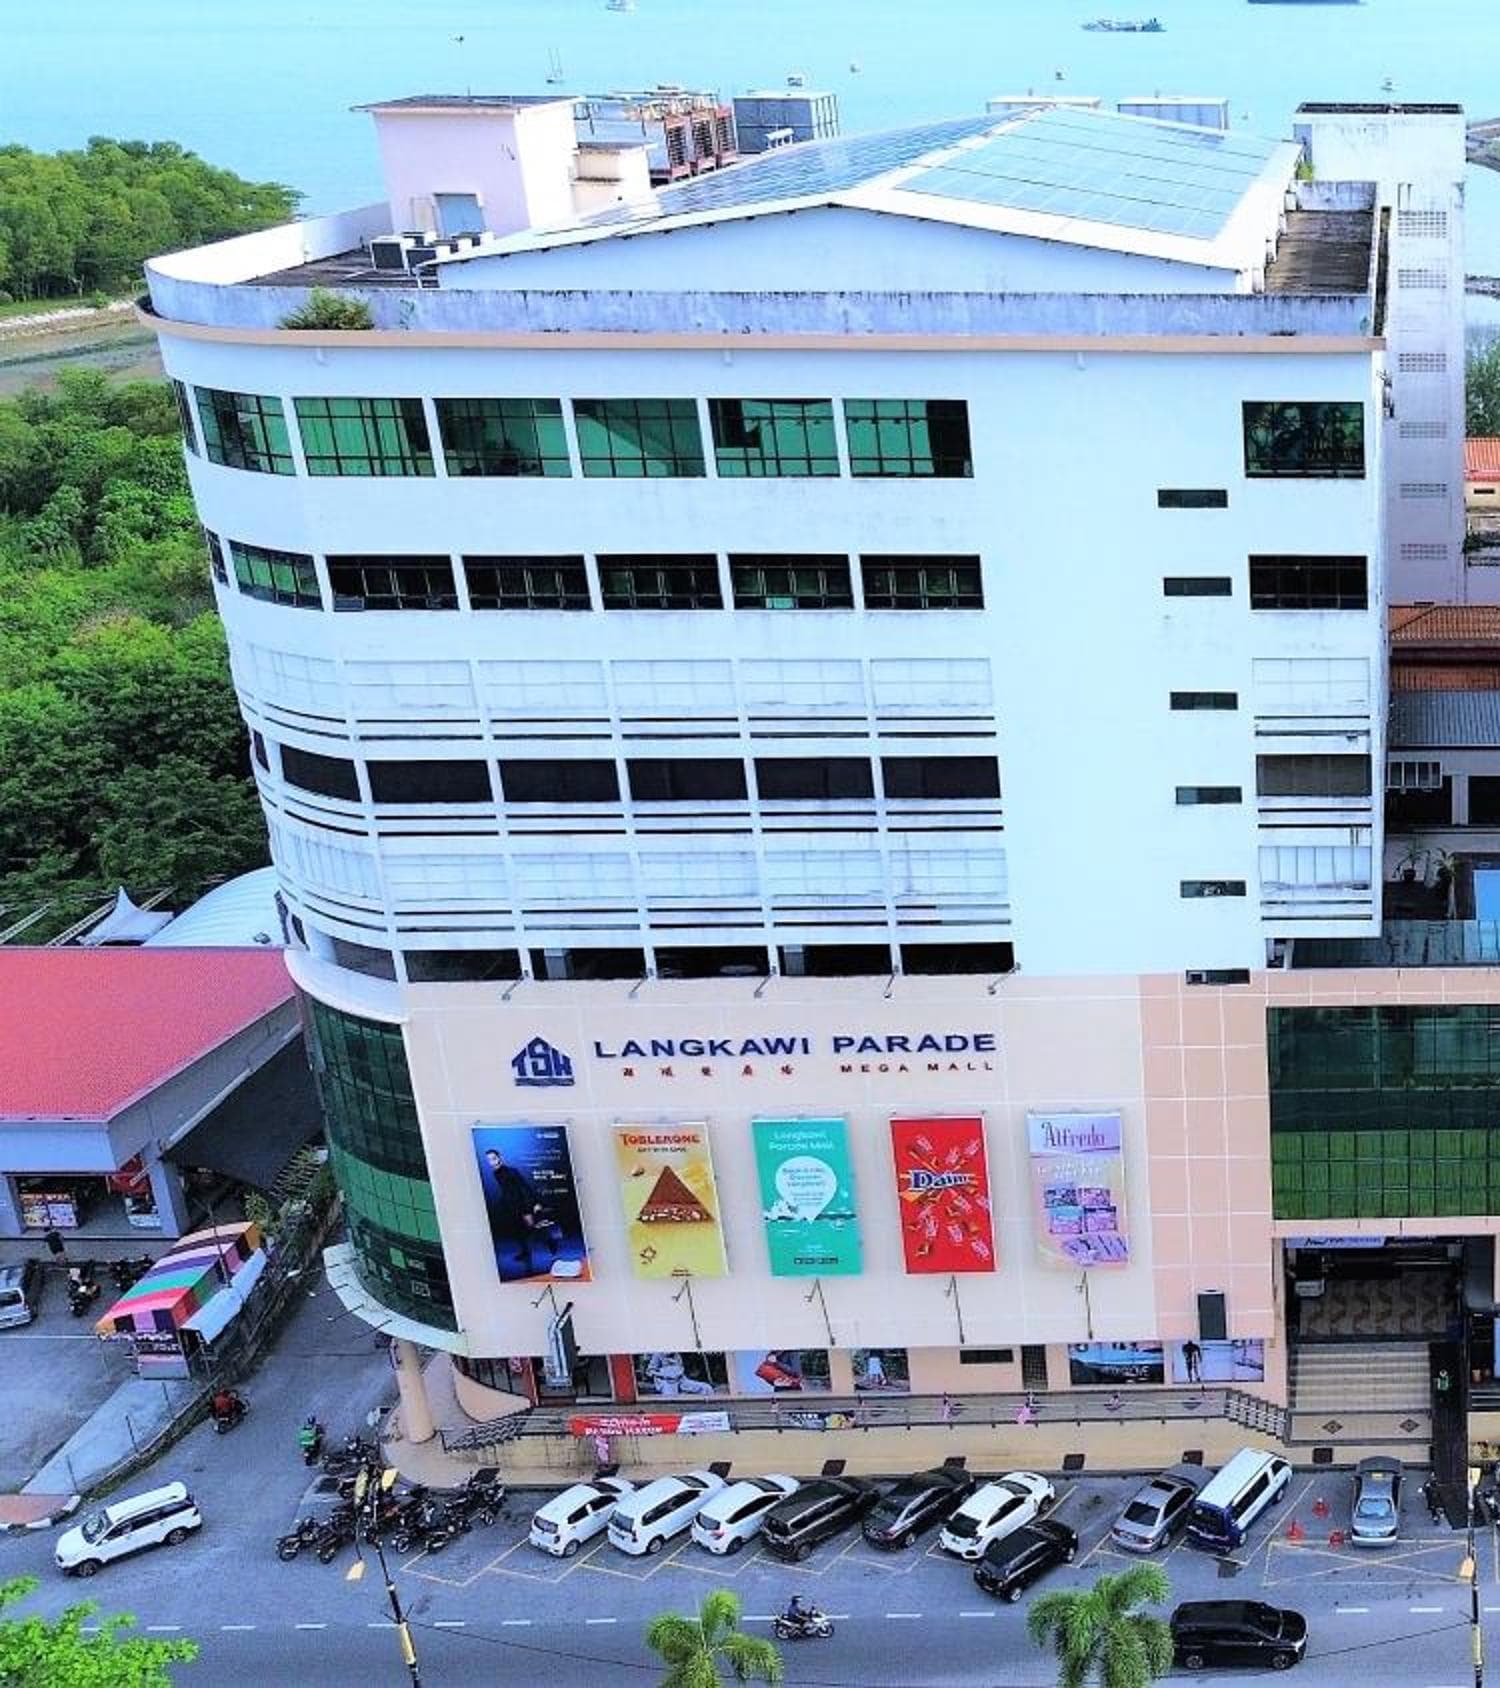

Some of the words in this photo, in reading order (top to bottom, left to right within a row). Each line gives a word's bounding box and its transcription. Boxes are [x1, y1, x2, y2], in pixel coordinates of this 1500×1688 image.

[594, 1037, 810, 1058] LANGKAWI
[832, 1034, 997, 1053] PARADE
[840, 1063, 908, 1073] MEGA
[927, 1061, 993, 1072] MALL
[619, 1133, 701, 1146] TOBLERONE
[1041, 1122, 1106, 1147] Alfredo
